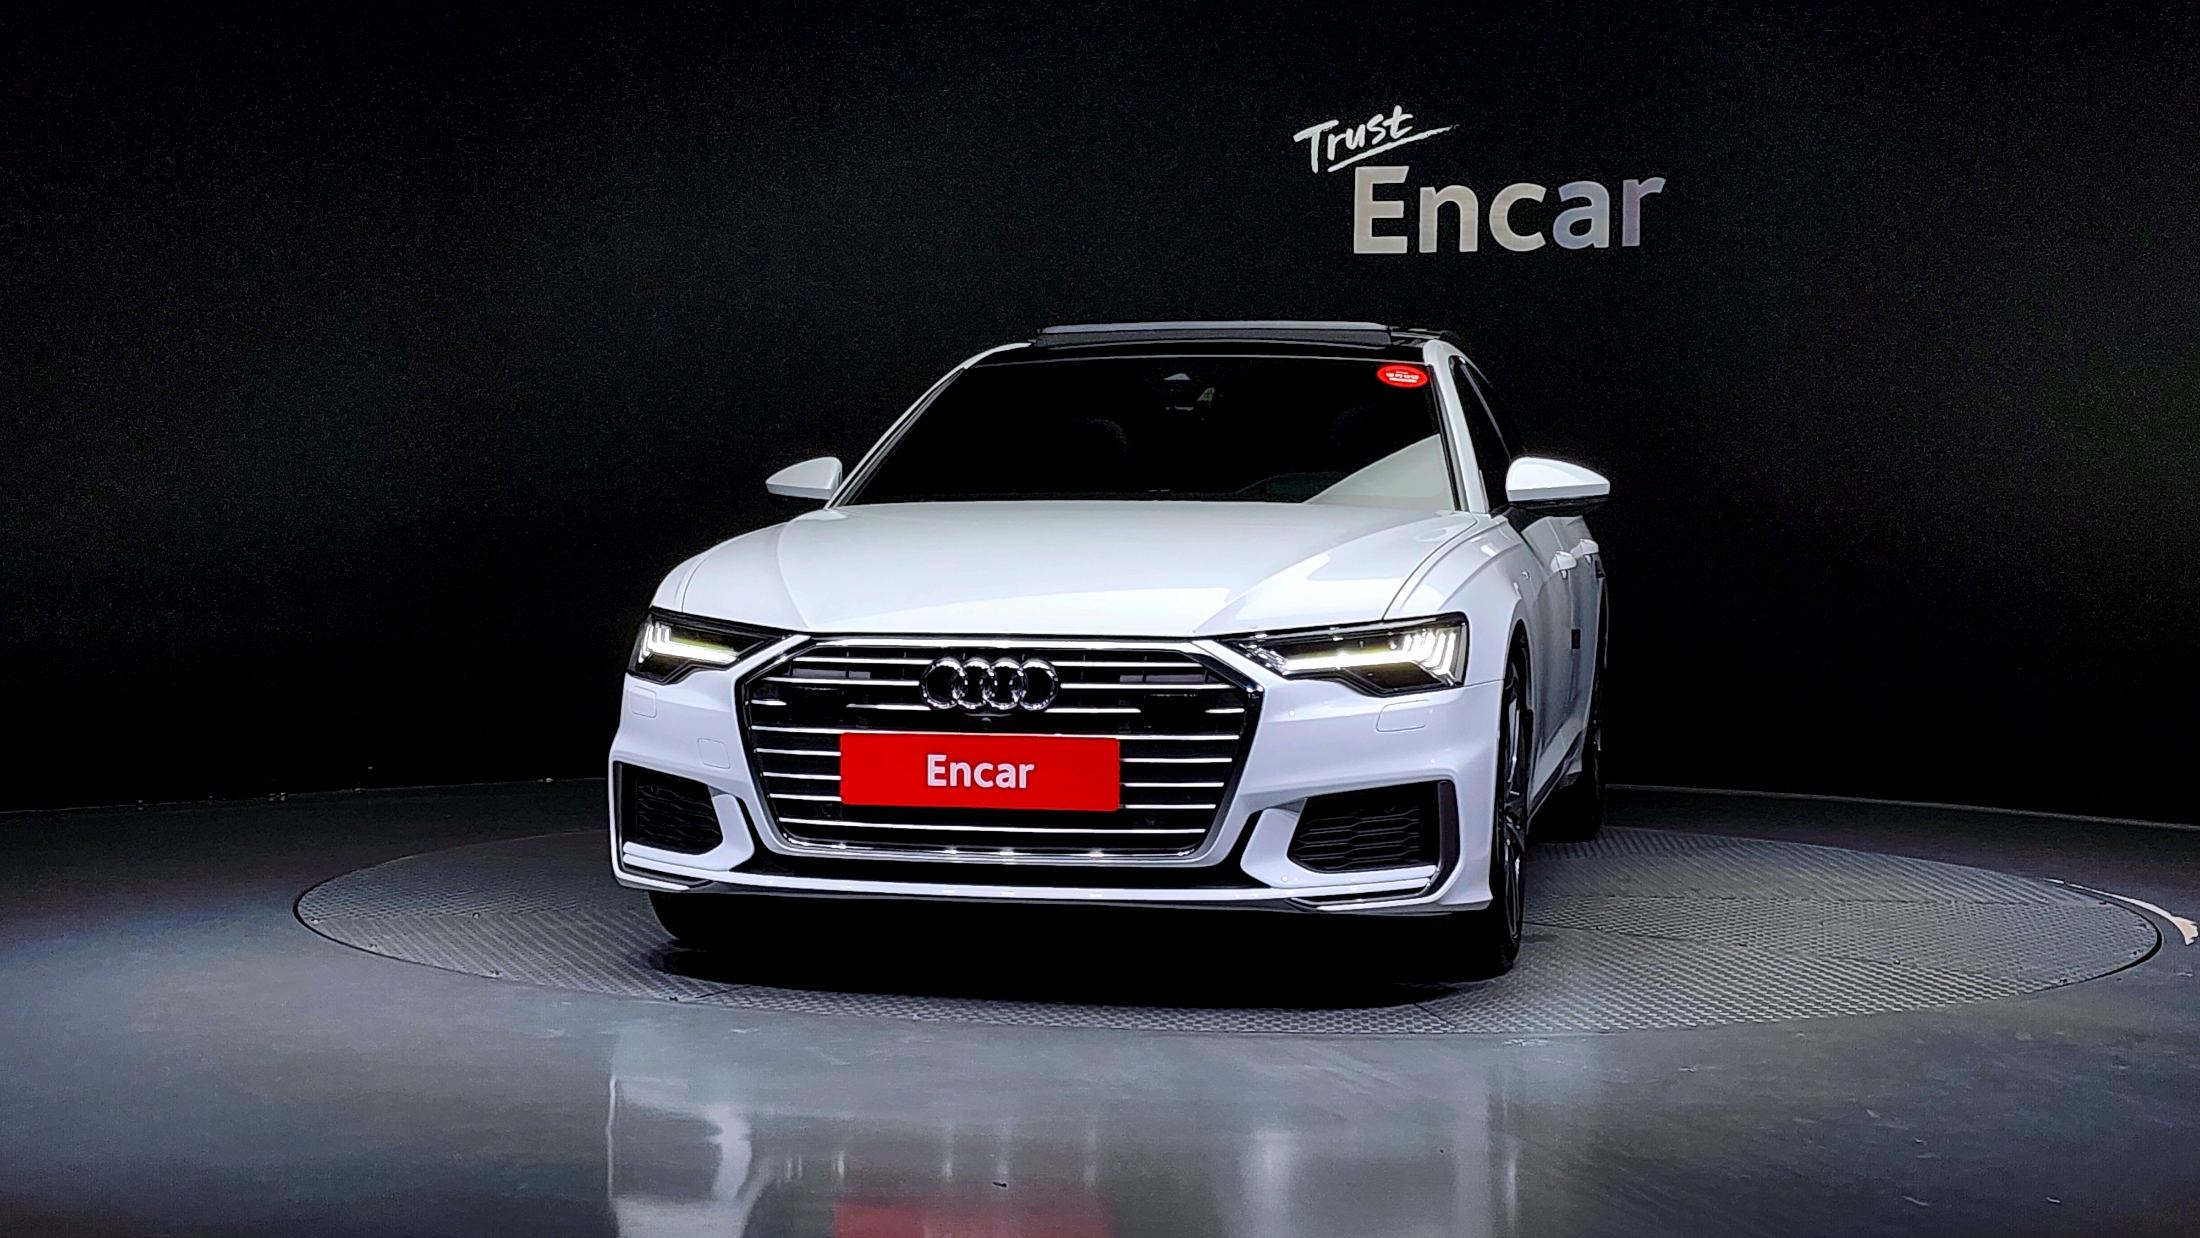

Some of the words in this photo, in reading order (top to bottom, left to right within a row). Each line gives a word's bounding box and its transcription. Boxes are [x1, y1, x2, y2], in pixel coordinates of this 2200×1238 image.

[1293, 105, 1414, 173] Trust
[1354, 166, 1666, 254] Encar
[927, 754, 1034, 788] Encar
